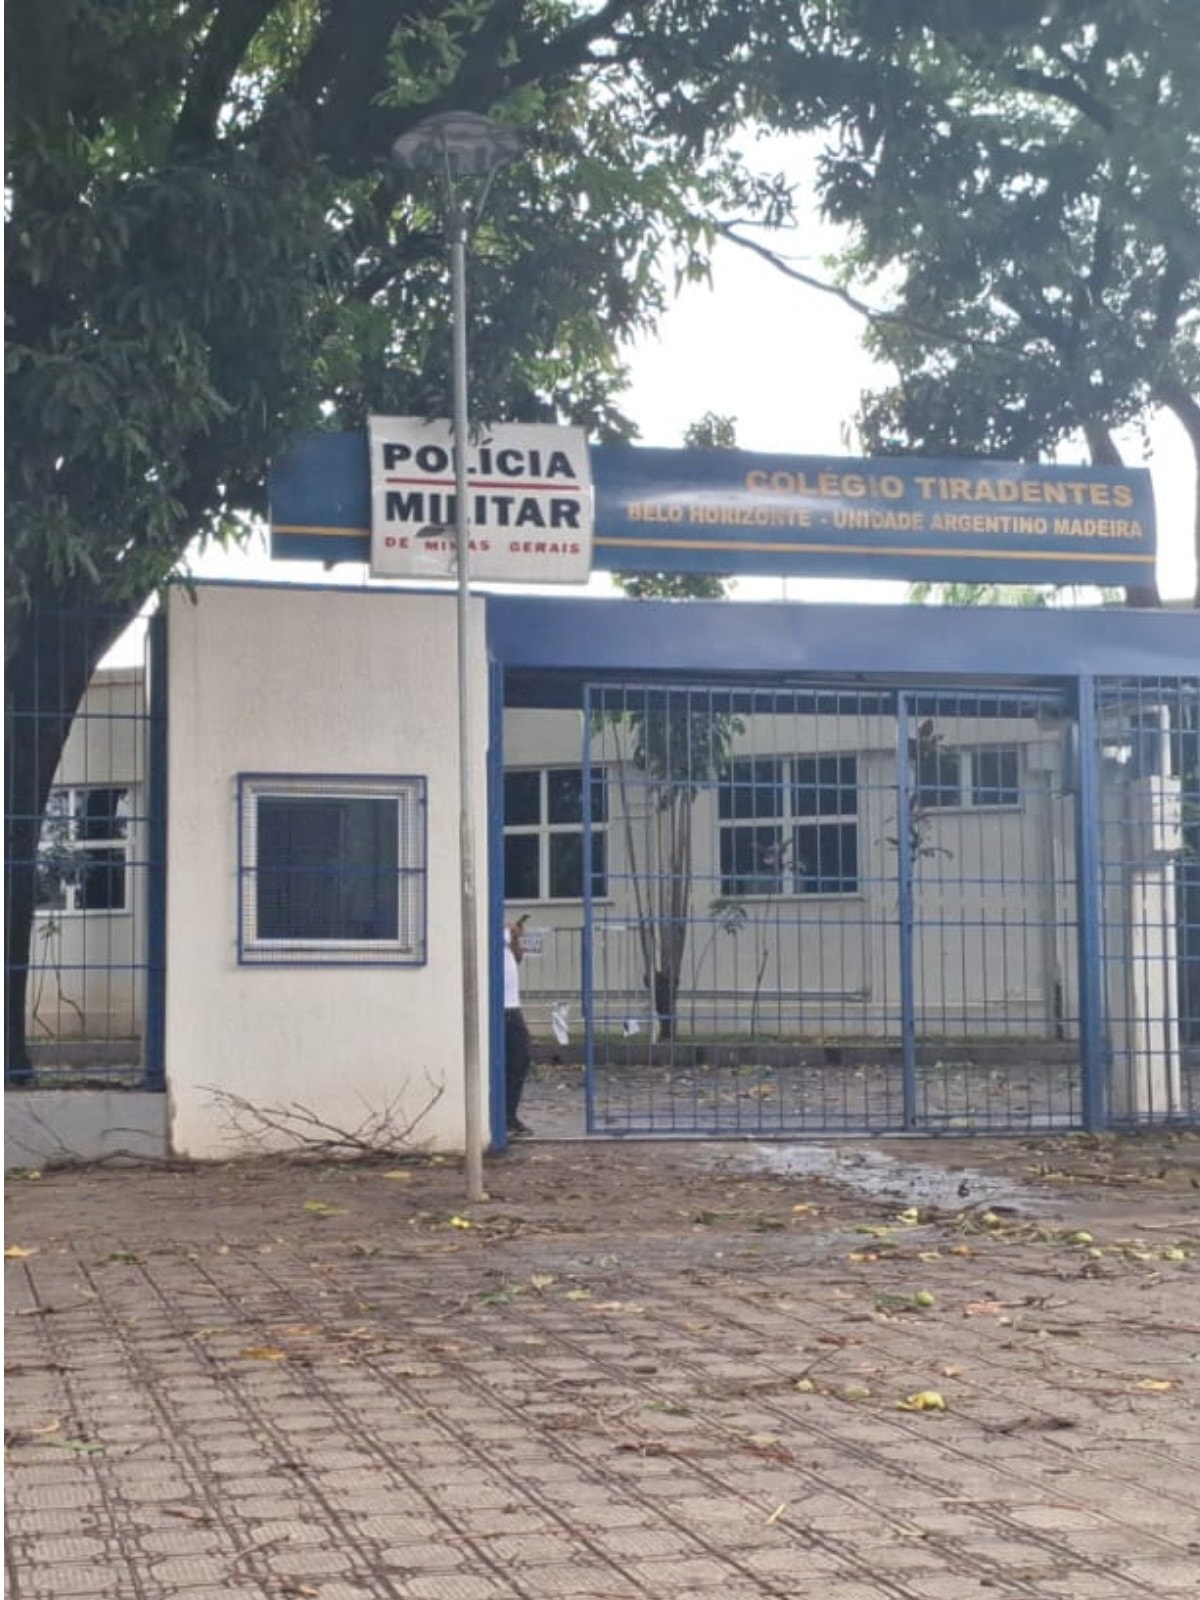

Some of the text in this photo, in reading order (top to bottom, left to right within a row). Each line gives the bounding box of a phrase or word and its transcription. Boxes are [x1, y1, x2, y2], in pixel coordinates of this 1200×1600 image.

[914, 477, 1134, 508] TIRADENTES
[627, 502, 683, 523] BELO
[689, 504, 811, 527] HORIZONTE
[833, 510, 924, 530] UNIDADE
[930, 513, 1047, 534] ARGENTINO
[1054, 517, 1143, 538] MADEIRA
[384, 537, 409, 549] DE
[509, 541, 580, 554] GERAIS
